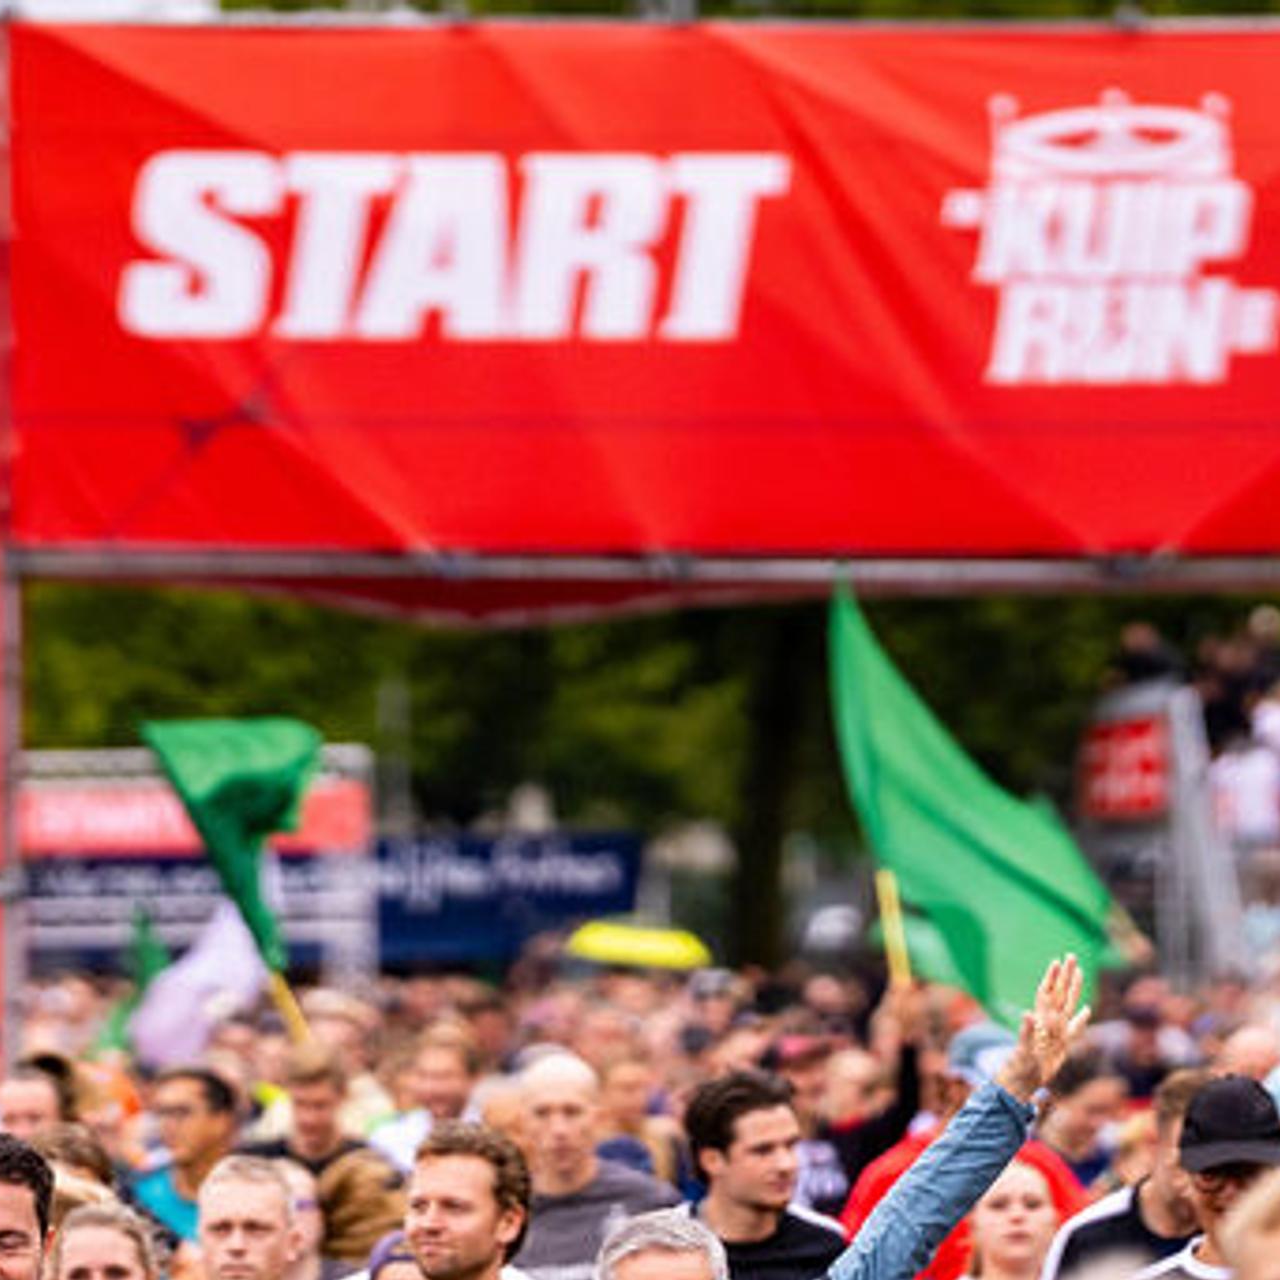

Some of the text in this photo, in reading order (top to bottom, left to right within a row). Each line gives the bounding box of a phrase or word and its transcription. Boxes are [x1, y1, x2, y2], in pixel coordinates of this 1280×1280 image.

[118, 148, 793, 342] START
[971, 178, 1255, 285] KUIP
[982, 276, 1230, 386] RUN
